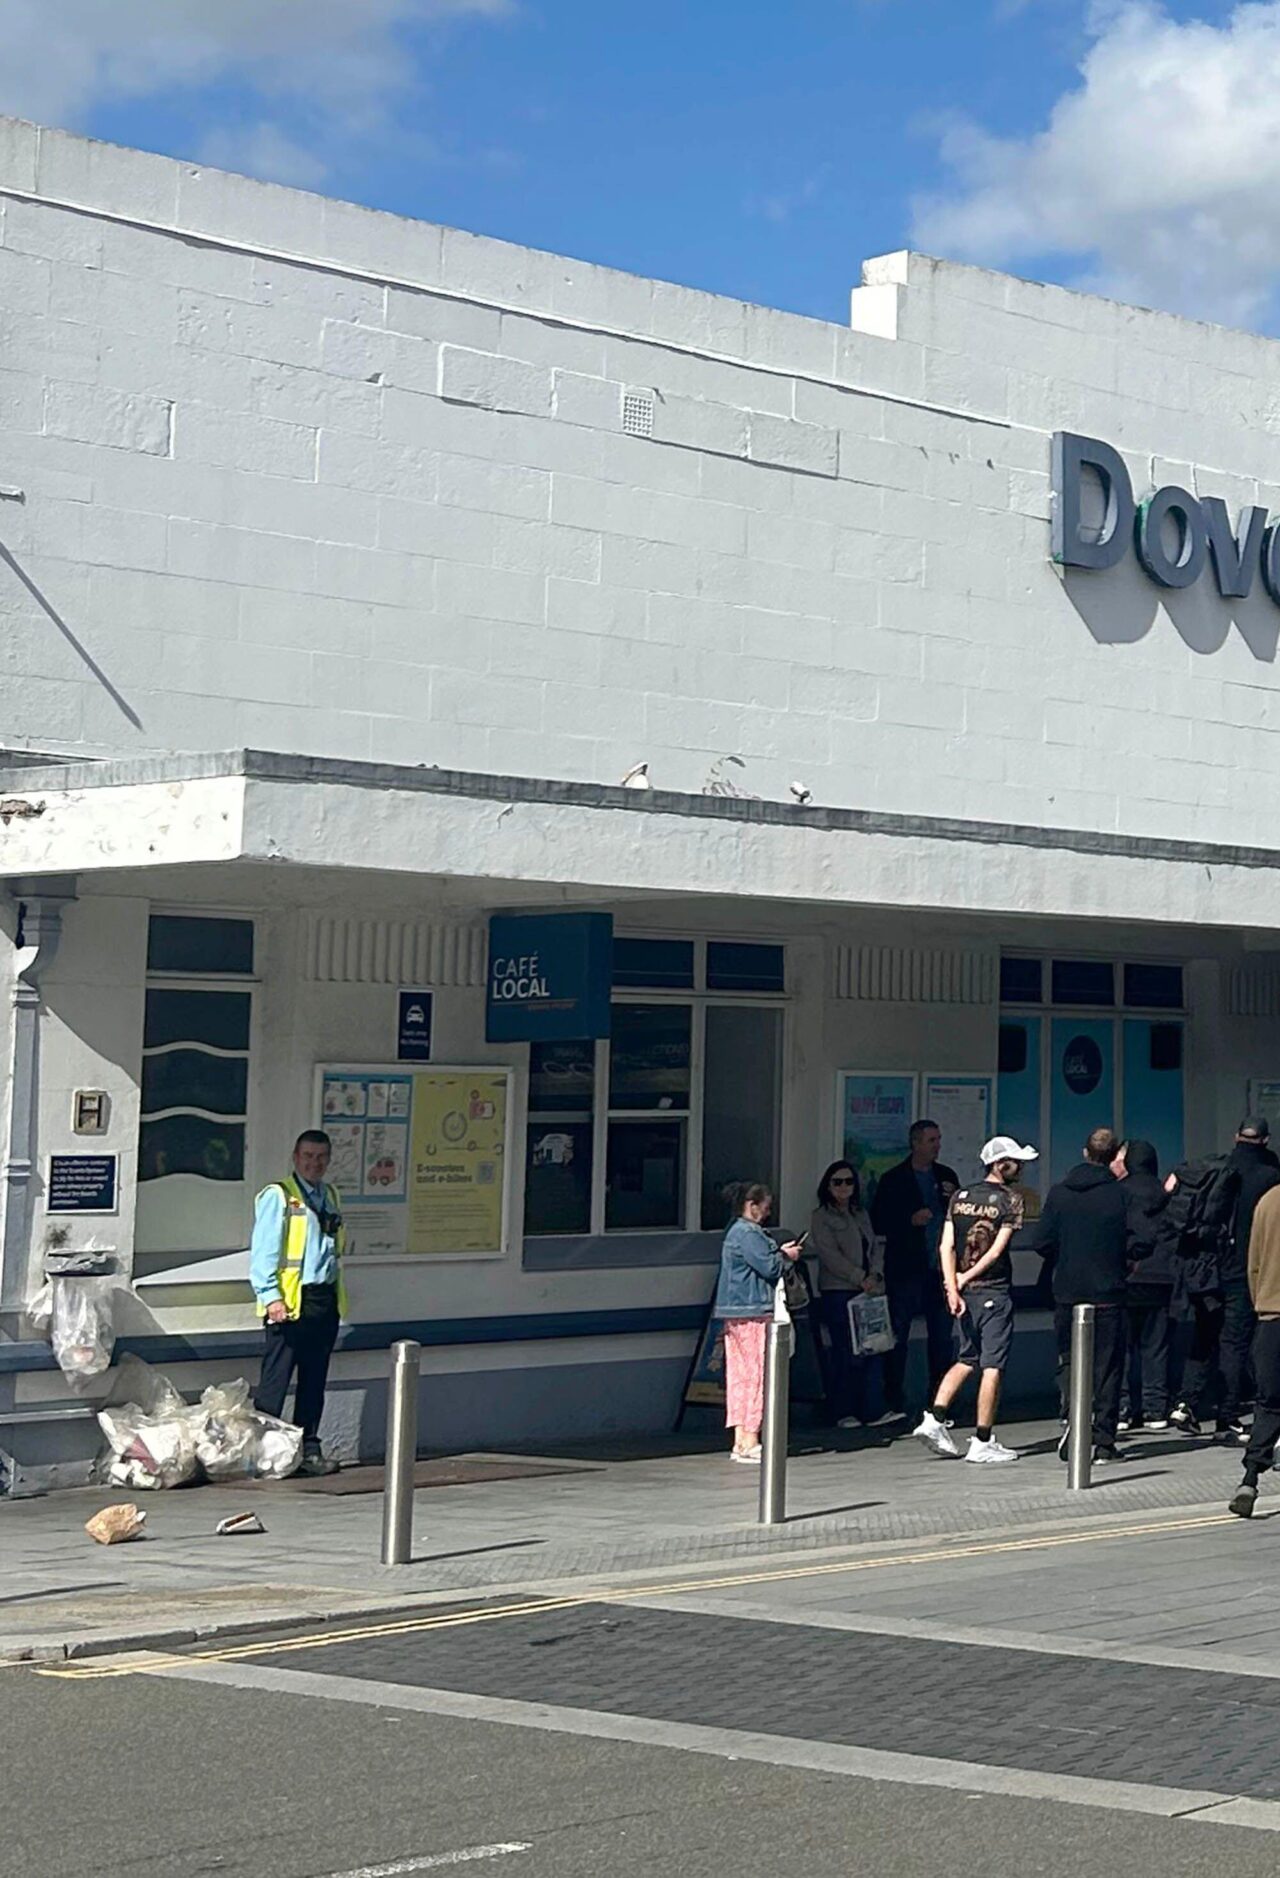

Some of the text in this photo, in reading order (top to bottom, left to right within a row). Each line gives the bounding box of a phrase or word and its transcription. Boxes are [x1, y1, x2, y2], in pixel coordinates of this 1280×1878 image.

[493, 950, 538, 978] CAFÉ
[493, 978, 550, 999] LOCAL
[953, 1202, 999, 1219] ENGLAND
